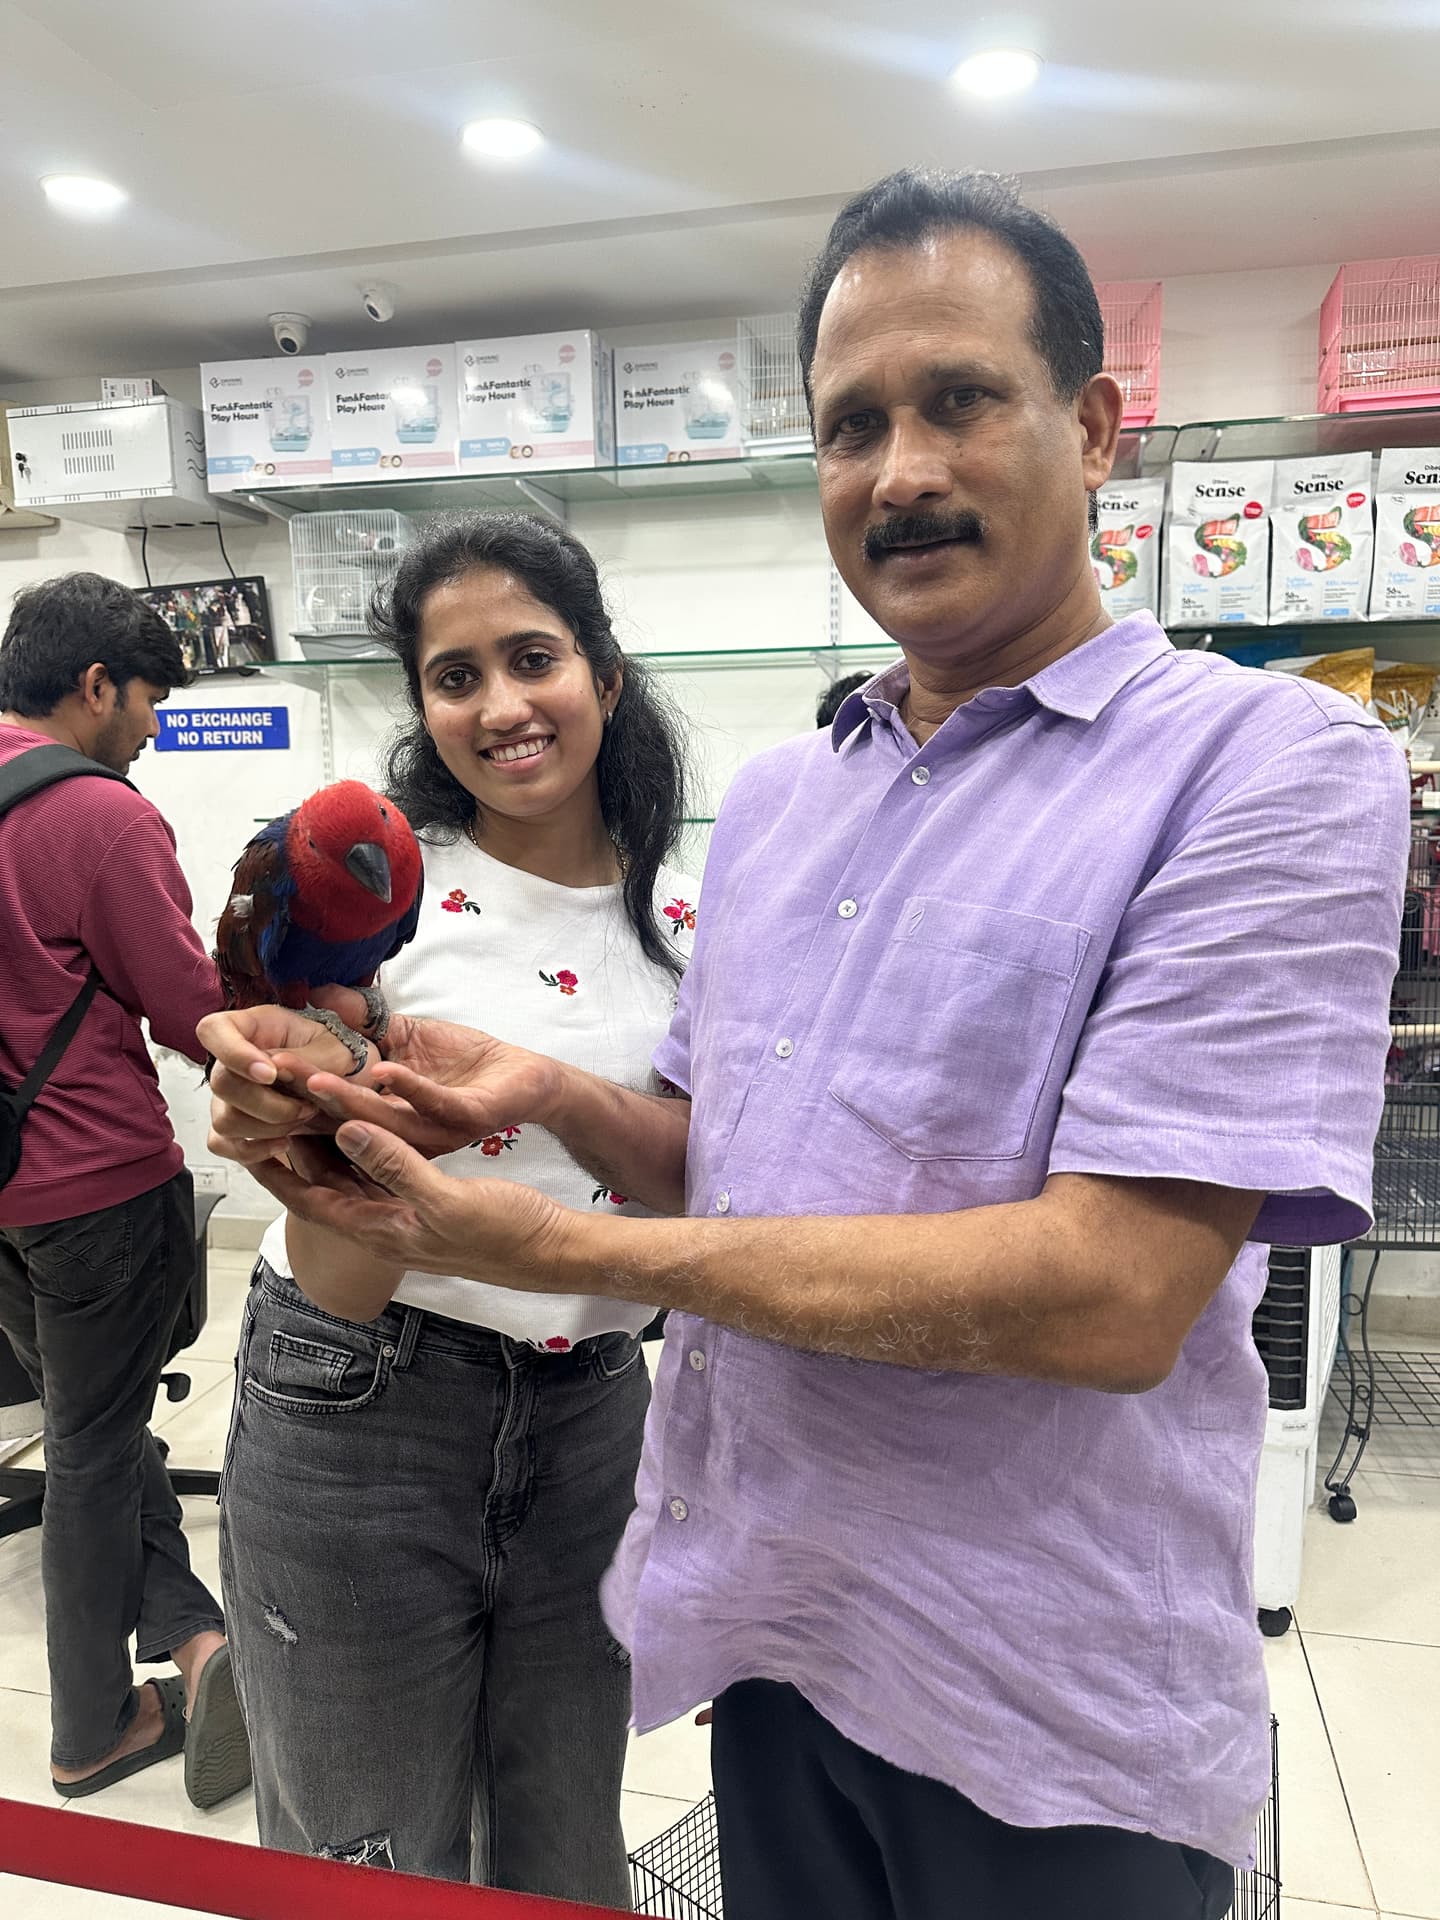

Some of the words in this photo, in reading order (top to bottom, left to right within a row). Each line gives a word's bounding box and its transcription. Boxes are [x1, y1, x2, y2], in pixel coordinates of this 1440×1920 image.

[466, 393, 487, 404] Play
[488, 391, 516, 401] House
[623, 398, 645, 410] Play
[646, 397, 675, 408] House
[210, 400, 273, 412] Fun&Fantastic
[336, 404, 358, 415] Play
[358, 402, 386, 413] House
[211, 414, 231, 424] Play
[232, 412, 260, 422] House
[1195, 485, 1246, 498] Sense
[1294, 479, 1344, 494] Sense
[1097, 500, 1139, 511] ense
[167, 714, 188, 728] NO
[192, 712, 273, 727] EXCHANGE
[178, 731, 200, 745] NO
[203, 730, 263, 745] RETURN
